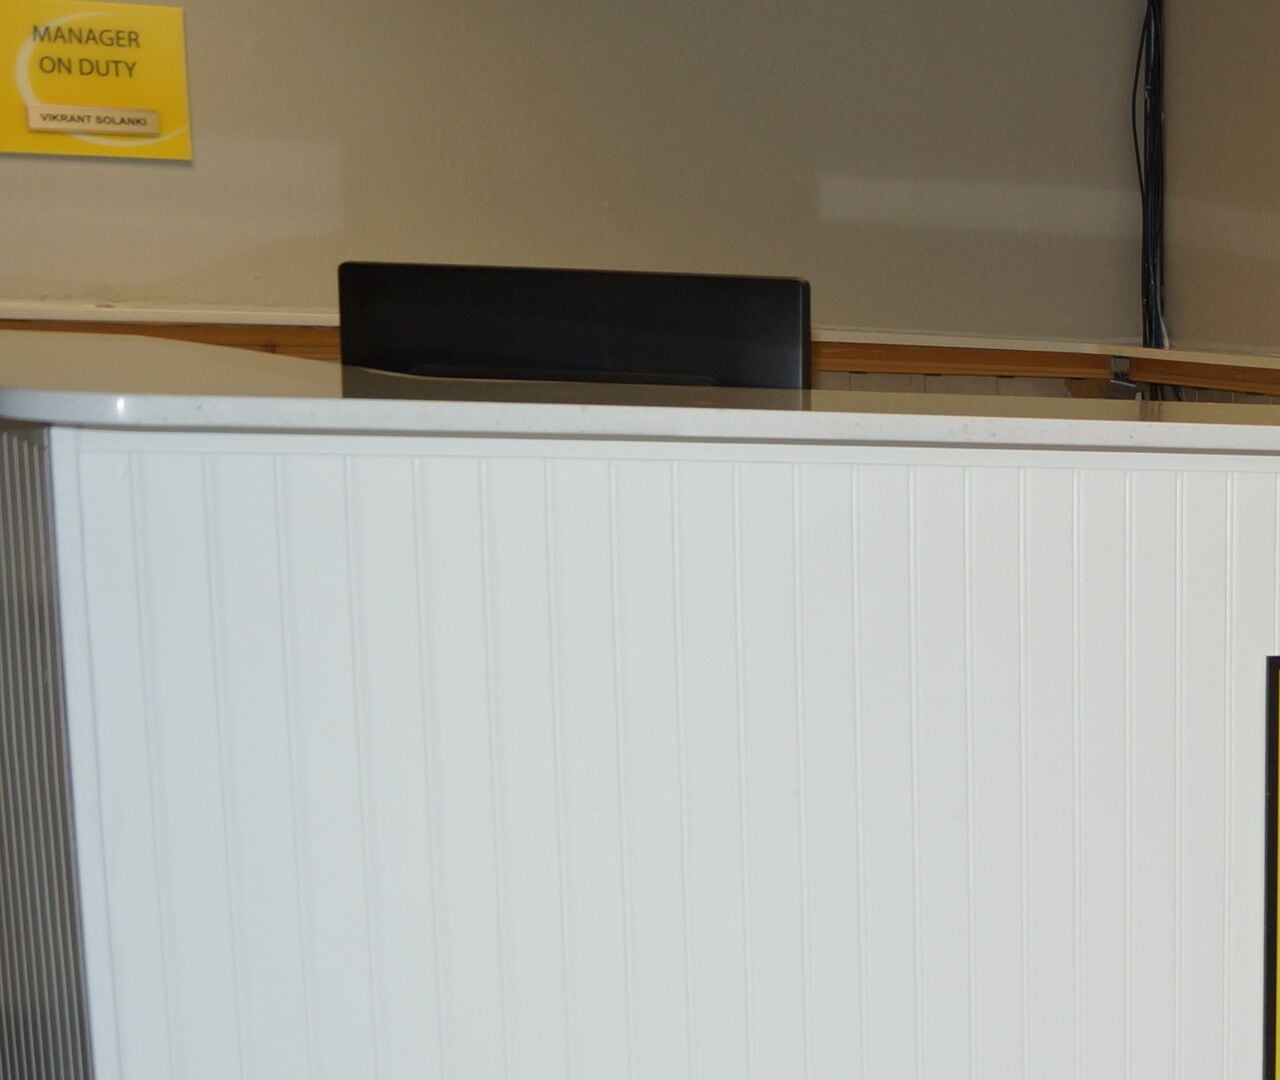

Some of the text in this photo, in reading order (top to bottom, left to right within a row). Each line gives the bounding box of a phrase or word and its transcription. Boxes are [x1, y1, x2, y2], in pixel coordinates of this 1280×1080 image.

[32, 25, 140, 48] MANAGER
[39, 55, 137, 78] ON DUTY
[40, 113, 147, 126] VIKRANT SOLANKI
